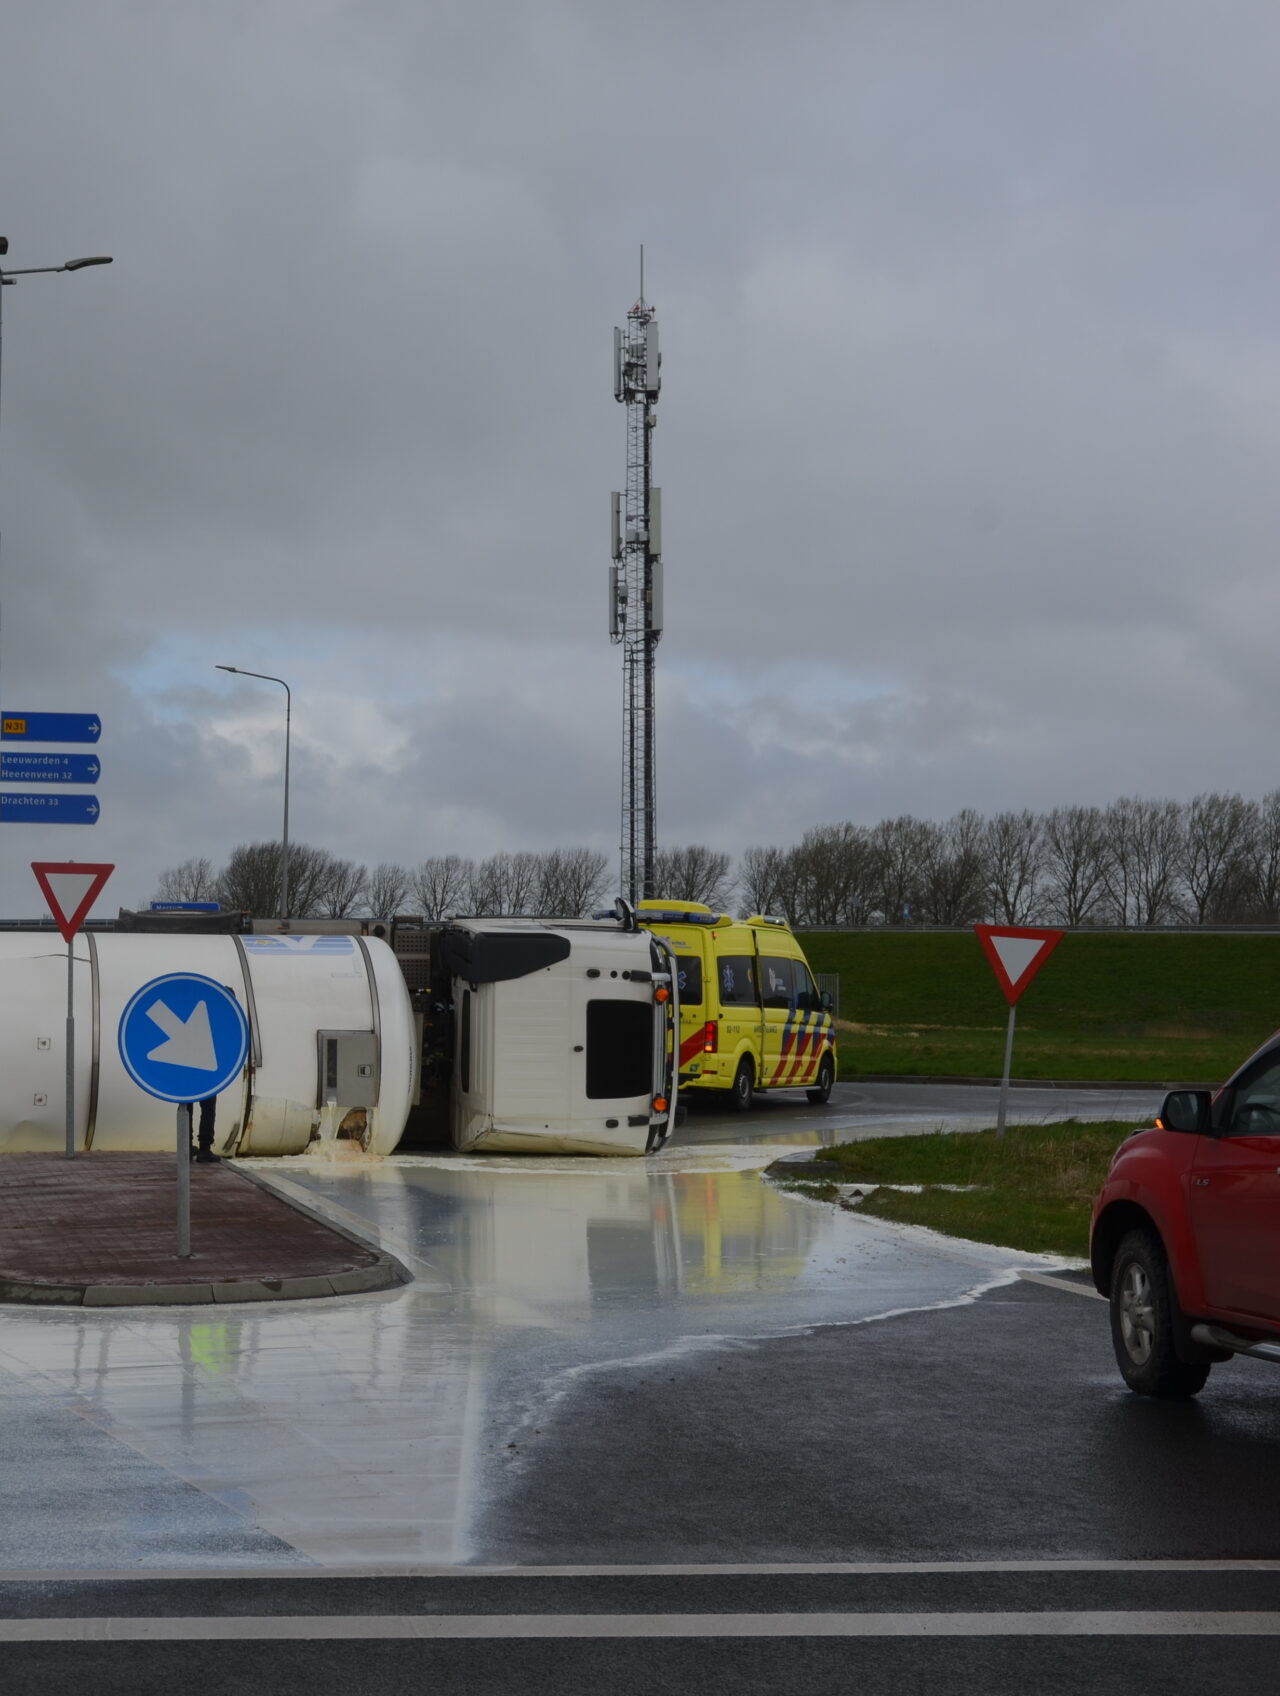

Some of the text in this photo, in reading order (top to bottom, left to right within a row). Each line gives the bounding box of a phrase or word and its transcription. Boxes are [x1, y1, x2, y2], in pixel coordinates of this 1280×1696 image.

[2, 756, 69, 765] Leeuwarden 4
[1, 769, 59, 779] Heerenveen
[1, 795, 58, 806] Drachten 33
